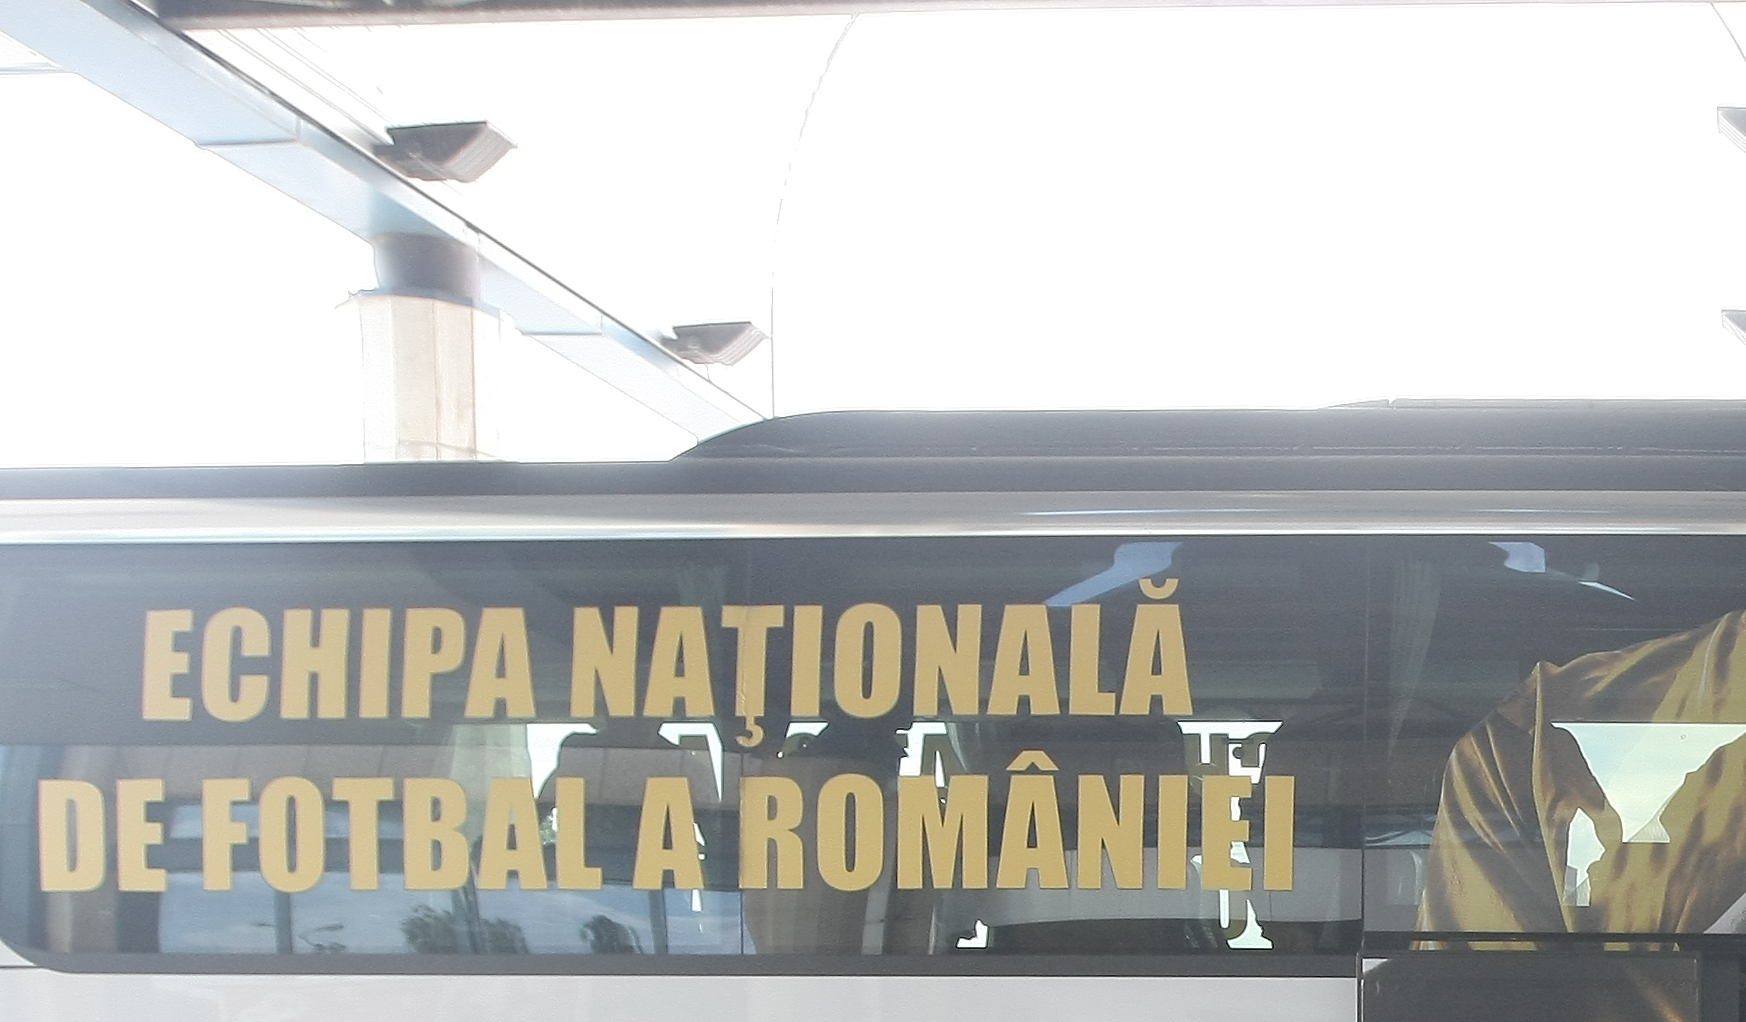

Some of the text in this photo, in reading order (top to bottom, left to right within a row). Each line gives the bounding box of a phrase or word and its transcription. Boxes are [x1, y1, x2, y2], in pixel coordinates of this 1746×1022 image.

[142, 606, 535, 721] ECHIPA
[38, 750, 1295, 893] DE FOTBAL A ROMÂNIEI
